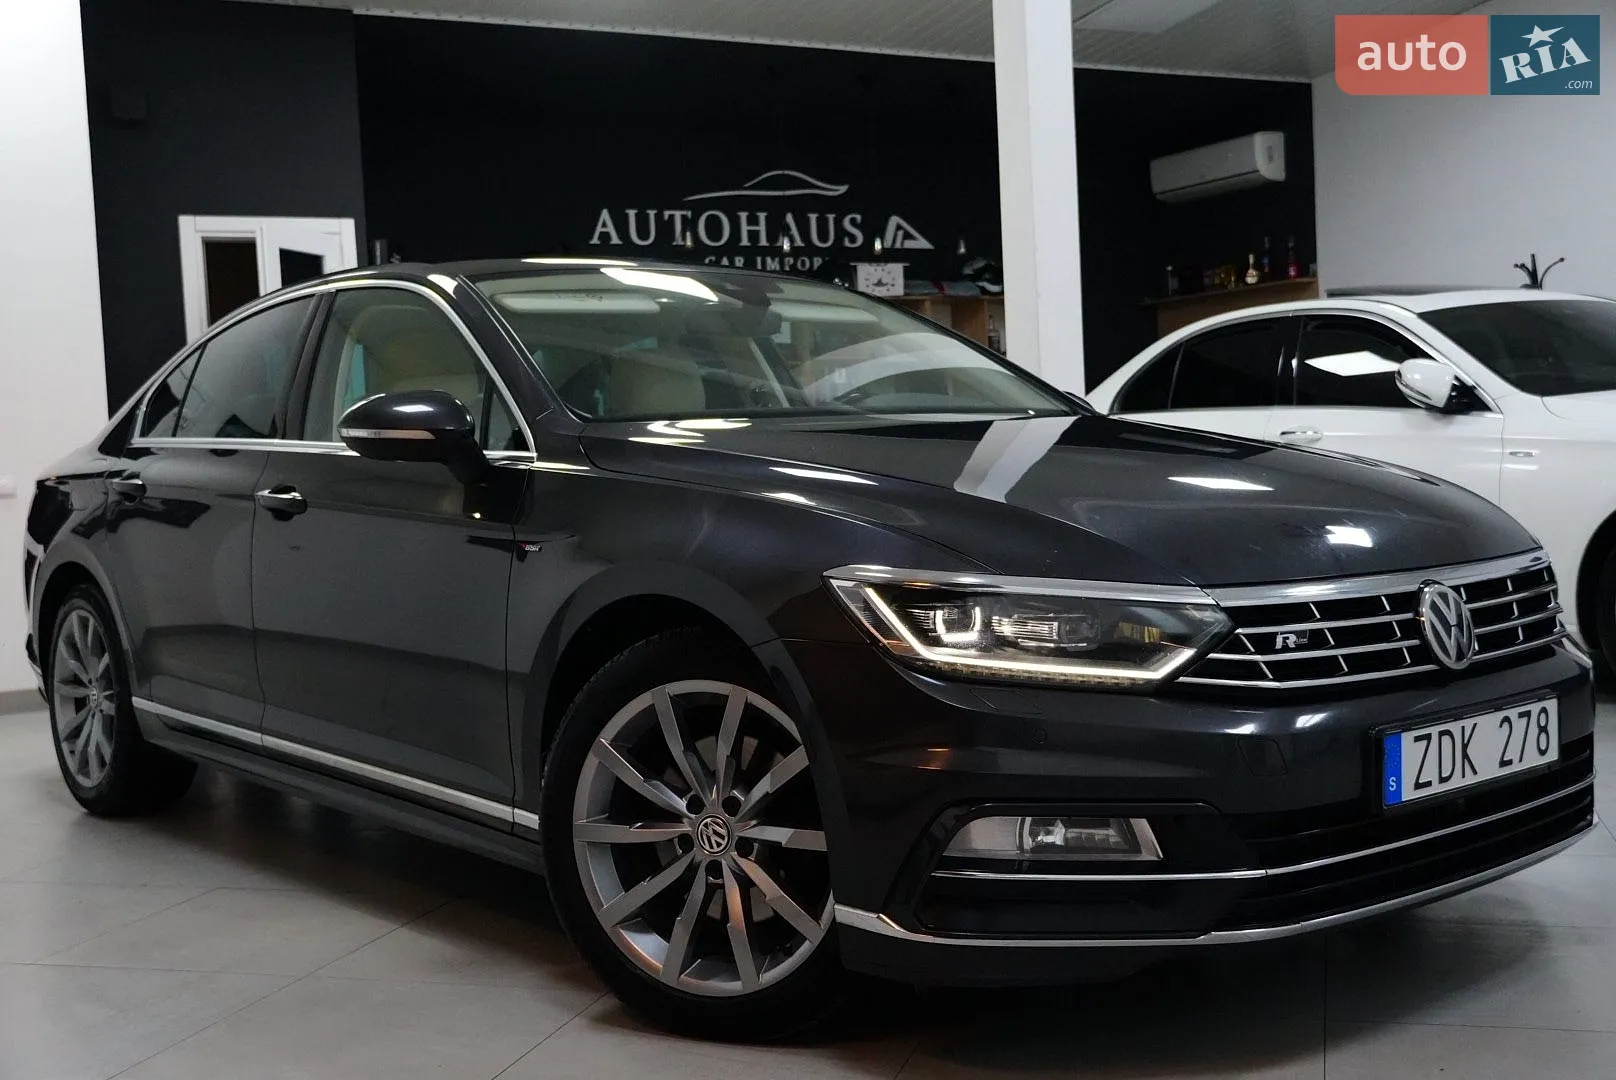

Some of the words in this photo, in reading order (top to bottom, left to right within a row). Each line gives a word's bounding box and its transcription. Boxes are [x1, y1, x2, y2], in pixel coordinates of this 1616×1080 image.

[589, 208, 864, 248] AUTOHAUS
[755, 256, 829, 271] IMPOR
[1413, 722, 1478, 791] ZDK
[1499, 706, 1550, 769] 278
[1388, 776, 1397, 791] S
